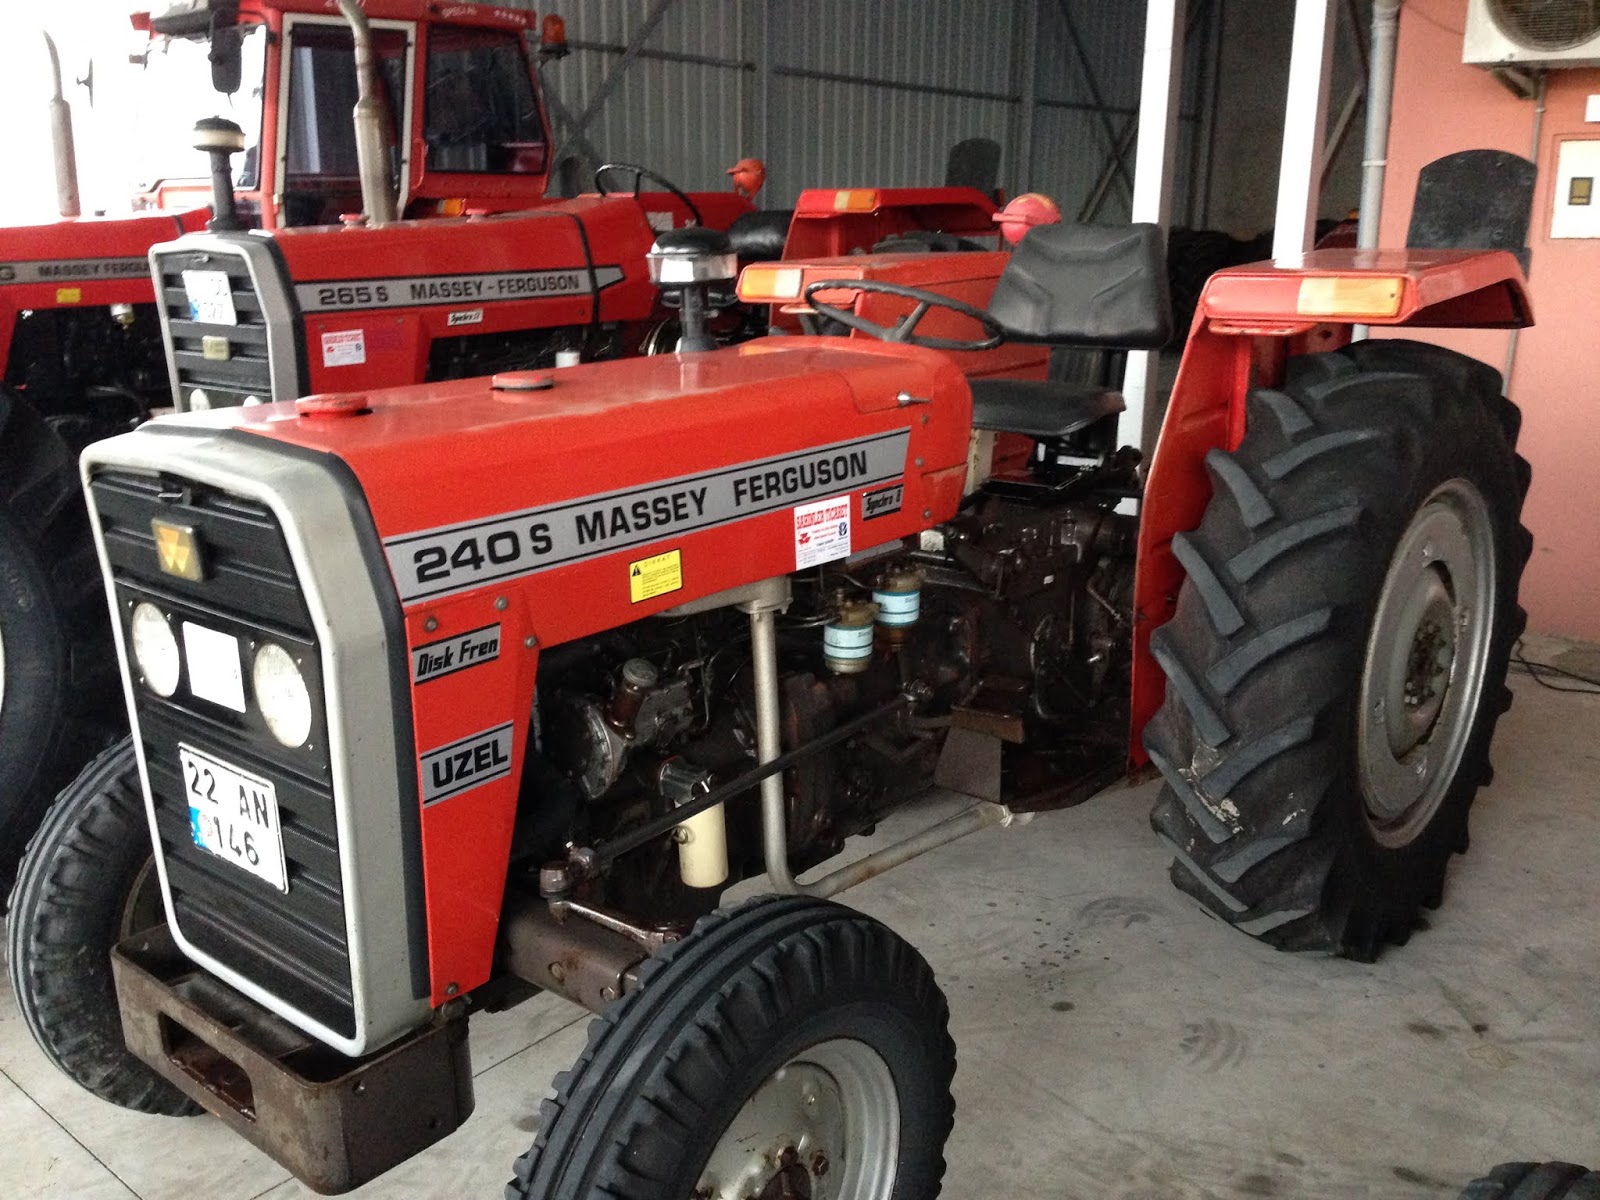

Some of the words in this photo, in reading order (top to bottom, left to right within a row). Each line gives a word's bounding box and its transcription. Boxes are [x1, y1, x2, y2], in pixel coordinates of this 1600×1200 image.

[575, 487, 707, 545] MASSEY
[733, 450, 868, 507] FERGUSON
[417, 646, 454, 677] Disk
[458, 638, 499, 663] Fren
[432, 739, 508, 788] UZEL
[188, 760, 219, 805] 22
[239, 784, 269, 829] AN
[213, 816, 260, 866] 146
